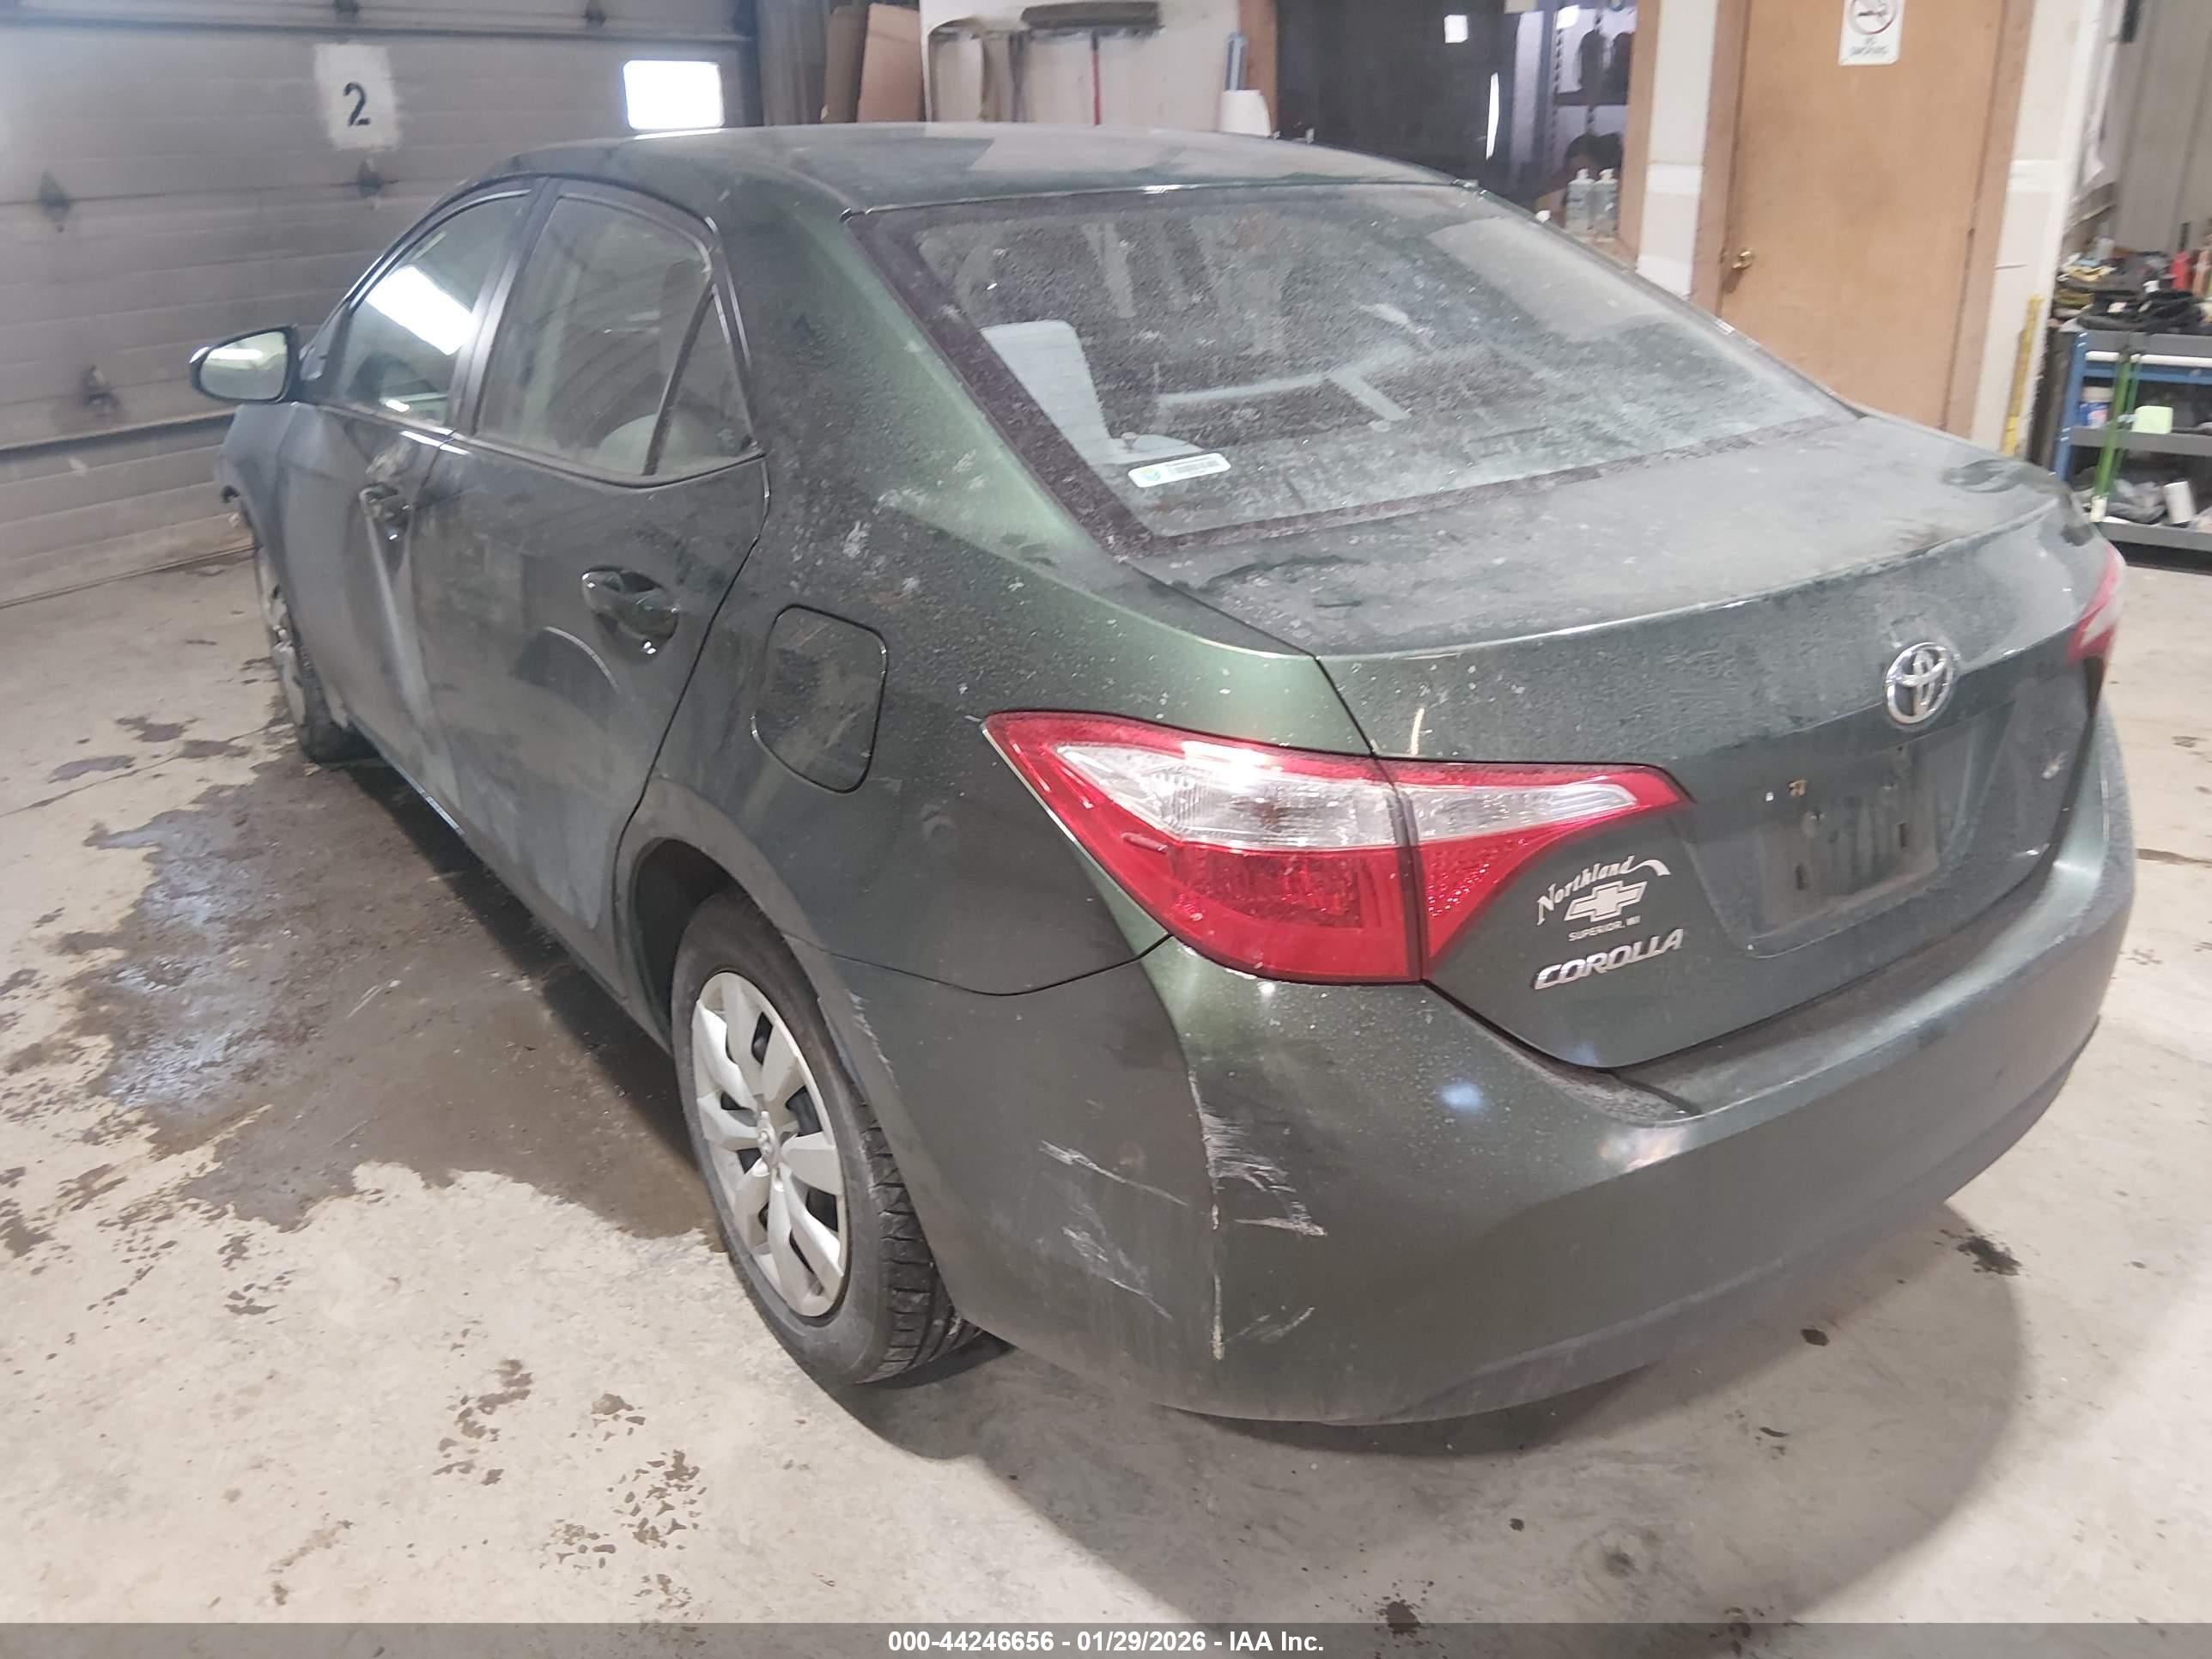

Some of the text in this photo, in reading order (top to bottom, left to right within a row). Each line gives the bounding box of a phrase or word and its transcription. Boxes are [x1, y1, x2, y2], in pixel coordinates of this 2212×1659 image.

[343, 81, 371, 127] 2
[1536, 854, 1671, 926] Northland
[1533, 928, 1685, 991] COROLLA
